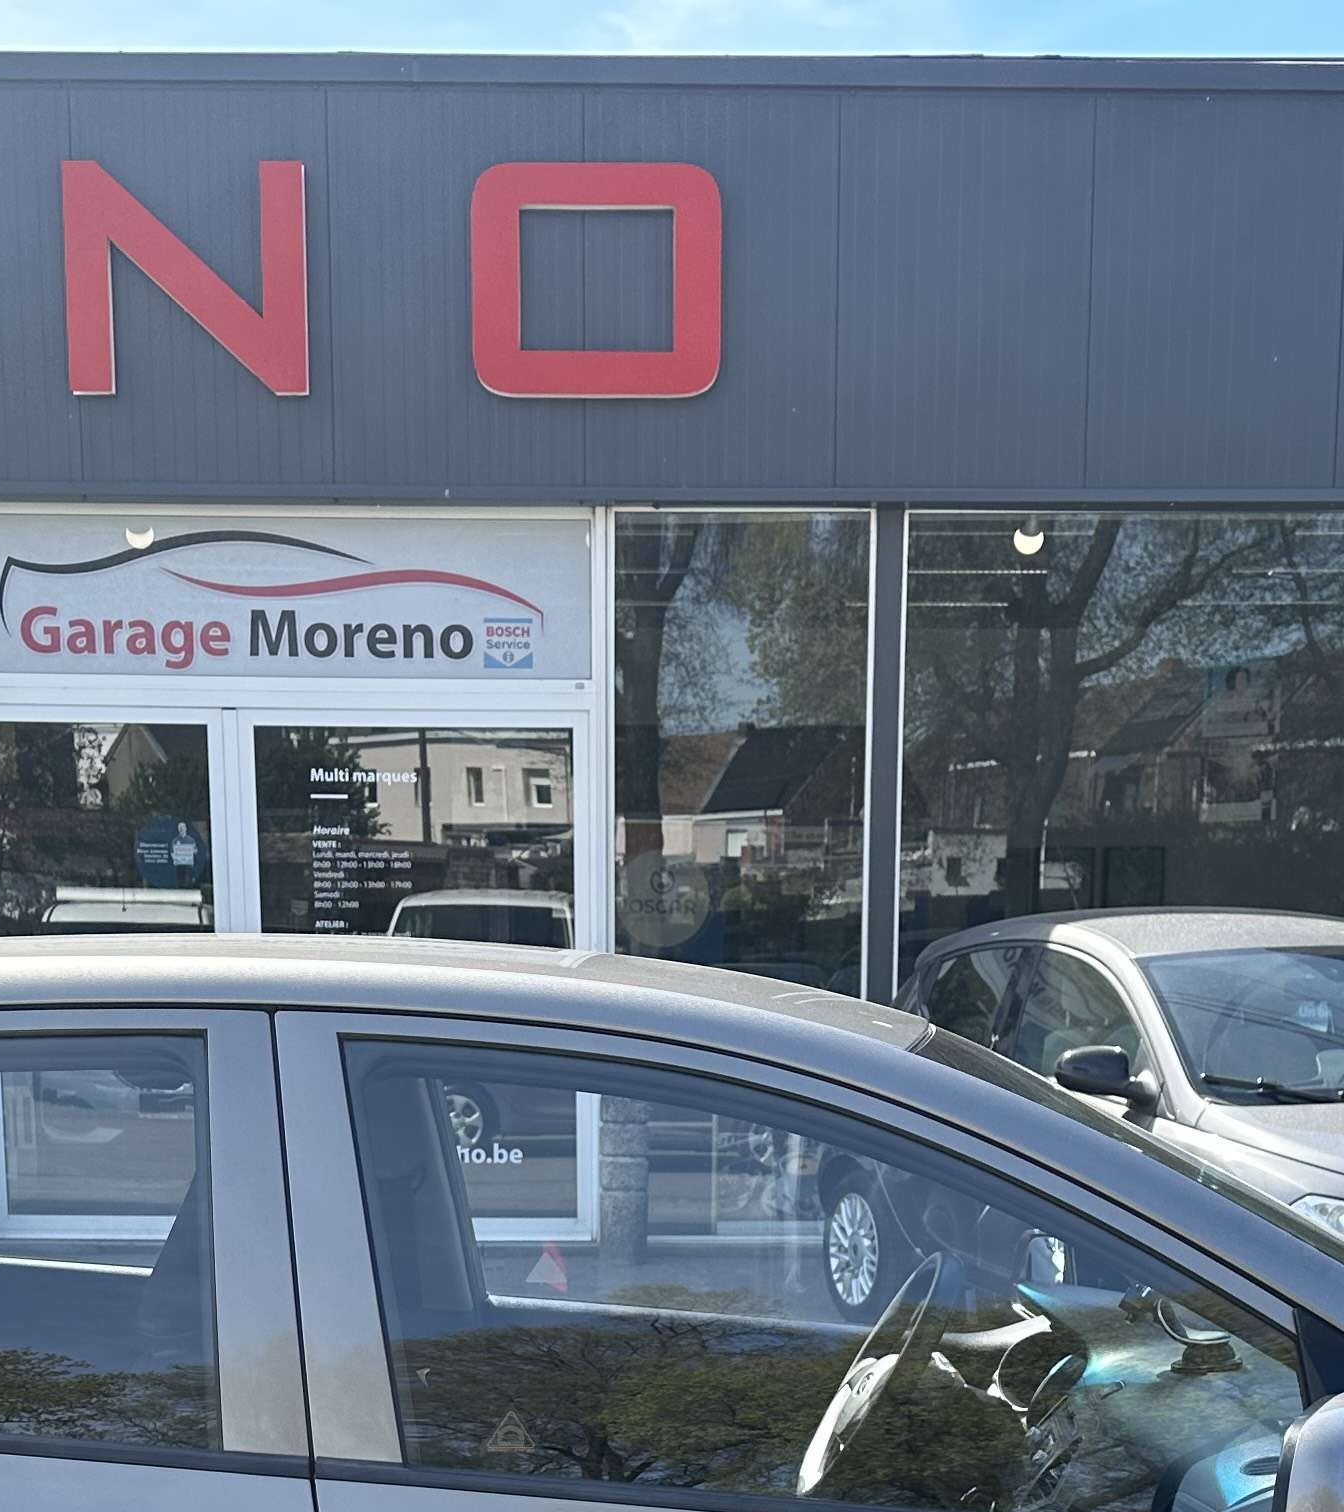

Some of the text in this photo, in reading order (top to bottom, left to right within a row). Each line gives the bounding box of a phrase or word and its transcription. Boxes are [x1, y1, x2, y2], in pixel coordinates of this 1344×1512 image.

[21, 606, 474, 670] Garage Moreno
[485, 625, 531, 638] BOSCH
[485, 639, 531, 650] Service
[310, 767, 418, 786] Multi marques
[312, 825, 351, 836] Horaire
[629, 898, 697, 914] OSCAR
